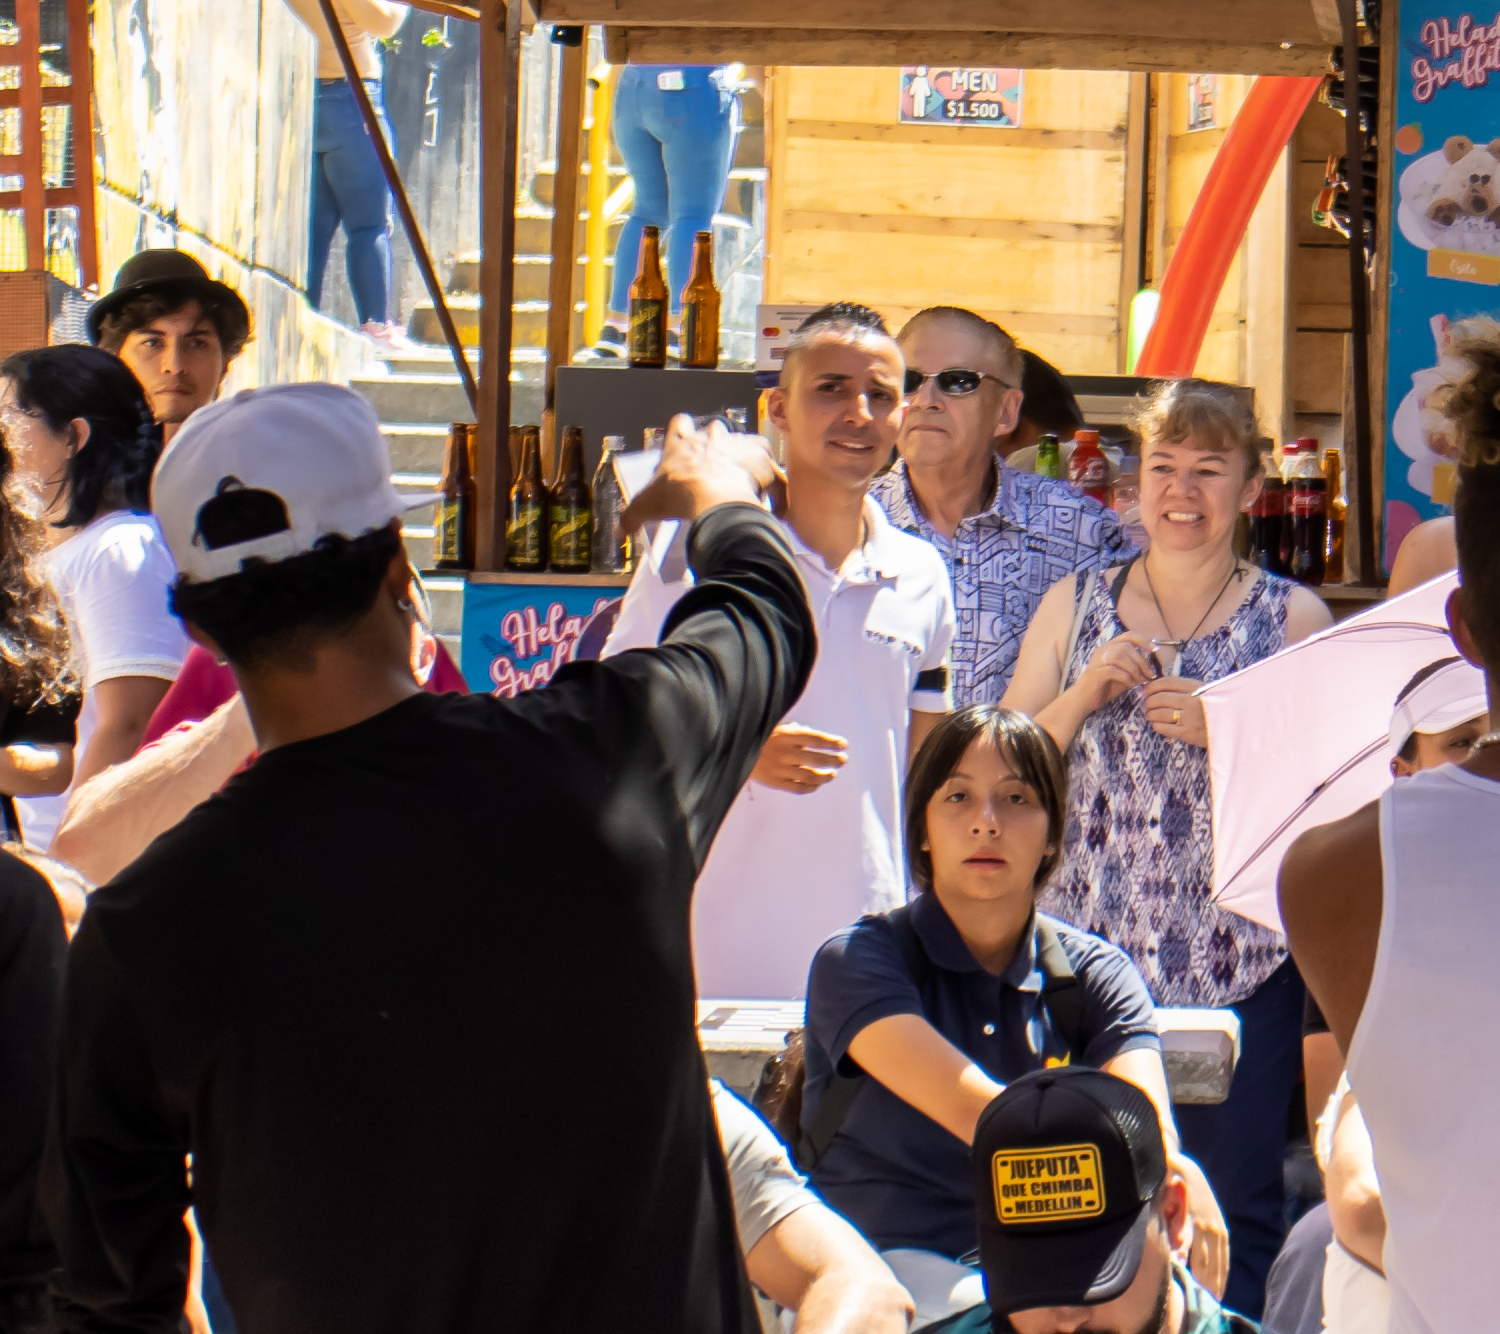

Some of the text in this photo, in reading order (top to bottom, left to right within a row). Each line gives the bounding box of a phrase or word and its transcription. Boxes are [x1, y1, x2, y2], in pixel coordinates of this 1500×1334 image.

[951, 70, 998, 93] MEN
[947, 101, 999, 119] $1.500
[501, 598, 608, 659] Hela
[1010, 1155, 1080, 1180] JUEPUTA
[1001, 1178, 1094, 1199] QUE CHIMBA
[1015, 1196, 1082, 1215] MEDELLIN
